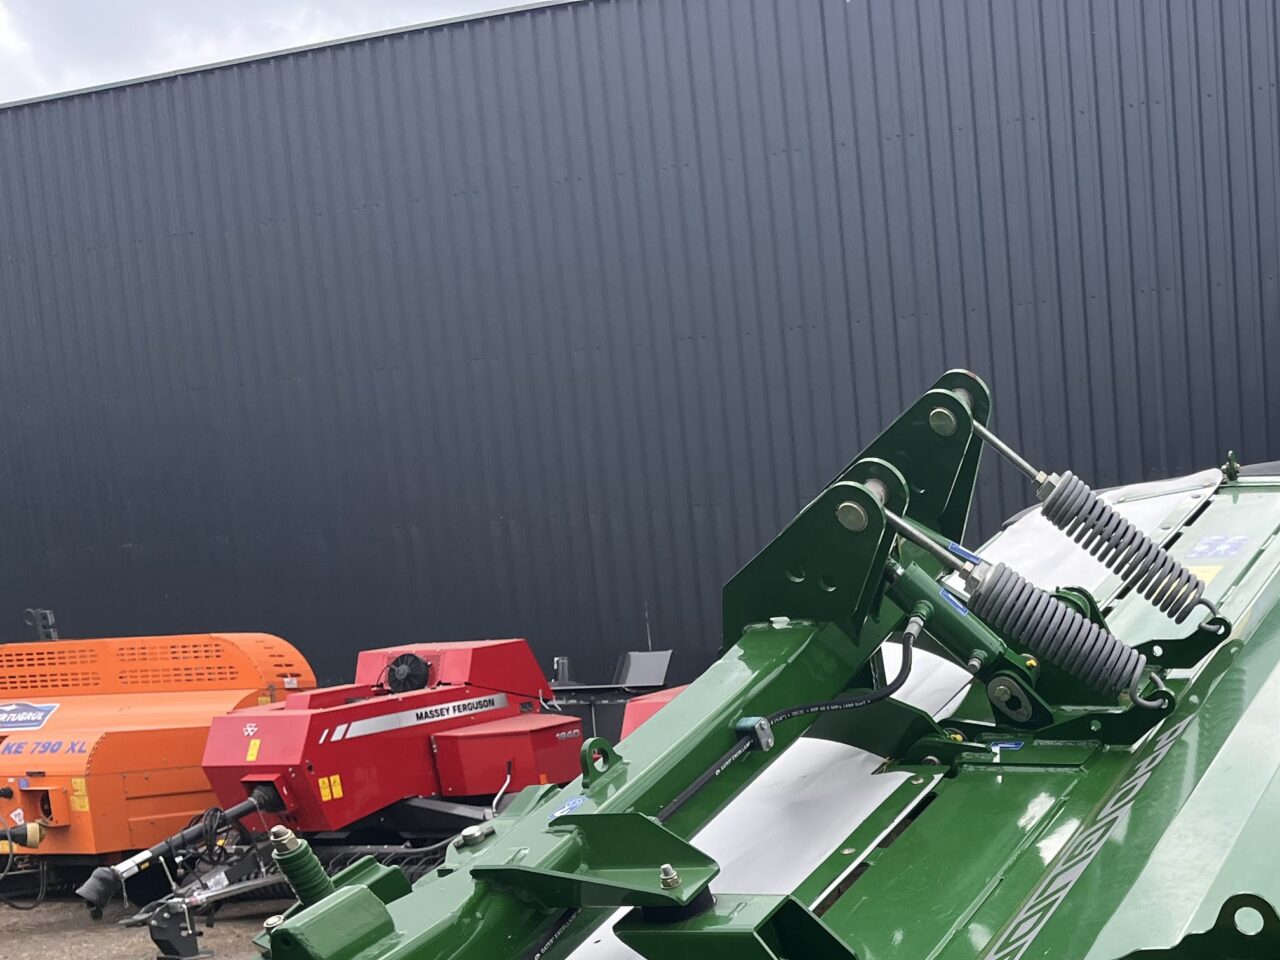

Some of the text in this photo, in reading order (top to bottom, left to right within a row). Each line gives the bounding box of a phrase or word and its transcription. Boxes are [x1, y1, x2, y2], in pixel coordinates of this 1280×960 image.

[415, 698, 495, 721] MASSEY FERGUSON
[1, 740, 87, 755] KE 790 XL
